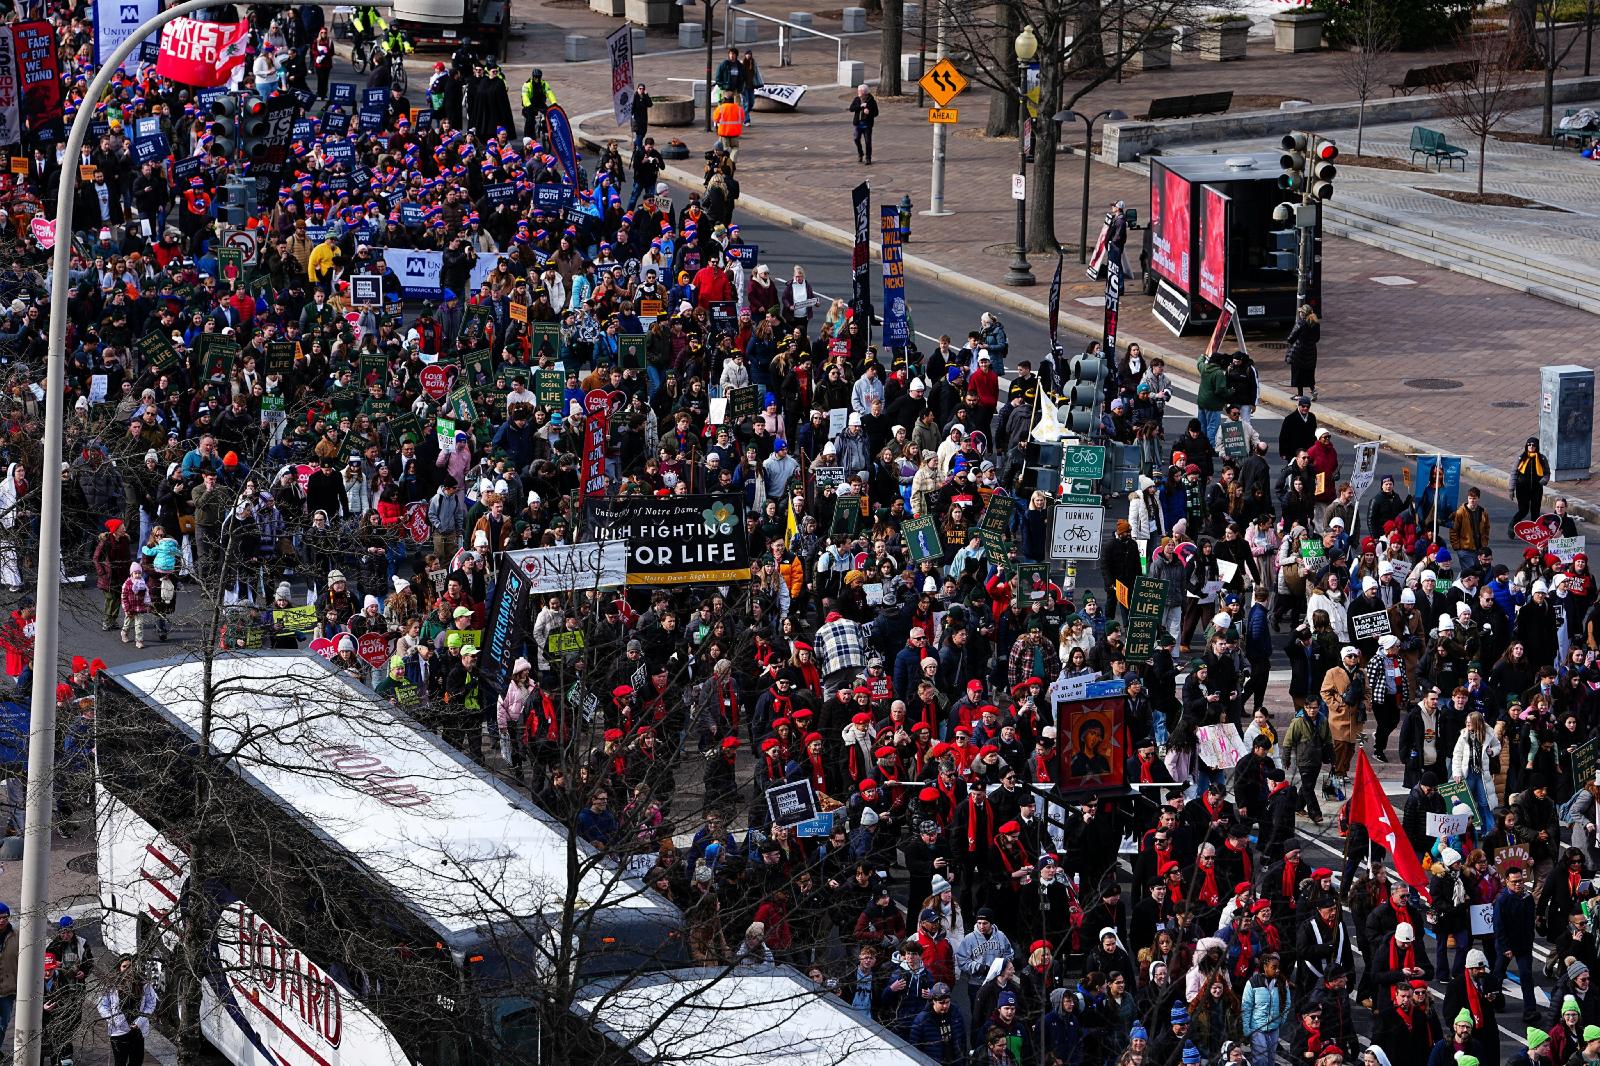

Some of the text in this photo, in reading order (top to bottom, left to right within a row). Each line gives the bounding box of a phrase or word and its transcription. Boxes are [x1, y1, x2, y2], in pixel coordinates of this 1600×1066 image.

[28, 35, 50, 49] FACE
[166, 35, 216, 64] LORD
[25, 60, 41, 72] WE
[25, 69, 53, 83] STAND
[335, 89, 350, 97] LIFE
[369, 93, 383, 101] LIFE
[328, 119, 344, 127] LIFE
[137, 145, 156, 156] LIFE
[353, 174, 369, 184] LIFE
[567, 213, 584, 224] LIFE
[152, 351, 173, 365] LIFE
[270, 360, 290, 368] LIFE
[541, 391, 561, 401] LIFE
[734, 402, 754, 412] LIFE
[634, 507, 643, 516] of
[645, 507, 671, 516] Notre
[674, 506, 700, 515] Dame
[1065, 511, 1094, 520] TURNING
[986, 518, 1004, 530] LIFE
[594, 521, 732, 540] IRISH FIGHTING
[1519, 525, 1540, 535] LOVE
[1525, 530, 1549, 541] BOTH
[682, 542, 737, 564] LIFE
[1054, 544, 1098, 554] USE X-WALKS
[990, 551, 1006, 562] LIFE
[542, 549, 606, 575] NALC
[722, 572, 737, 580] Life
[1141, 580, 1164, 590] SERVE
[1139, 591, 1162, 599] GOSPEL
[1136, 602, 1159, 615] LIFE
[490, 592, 513, 662] LUTHERANS
[1355, 620, 1389, 630] PRO-LIFE
[360, 639, 381, 647] LOVE
[362, 645, 384, 654] BOTH
[1129, 643, 1149, 654] LIFE
[1578, 766, 1596, 782] LIFE
[776, 792, 797, 802] make
[778, 799, 797, 808] more
[1495, 847, 1529, 864] STAND
